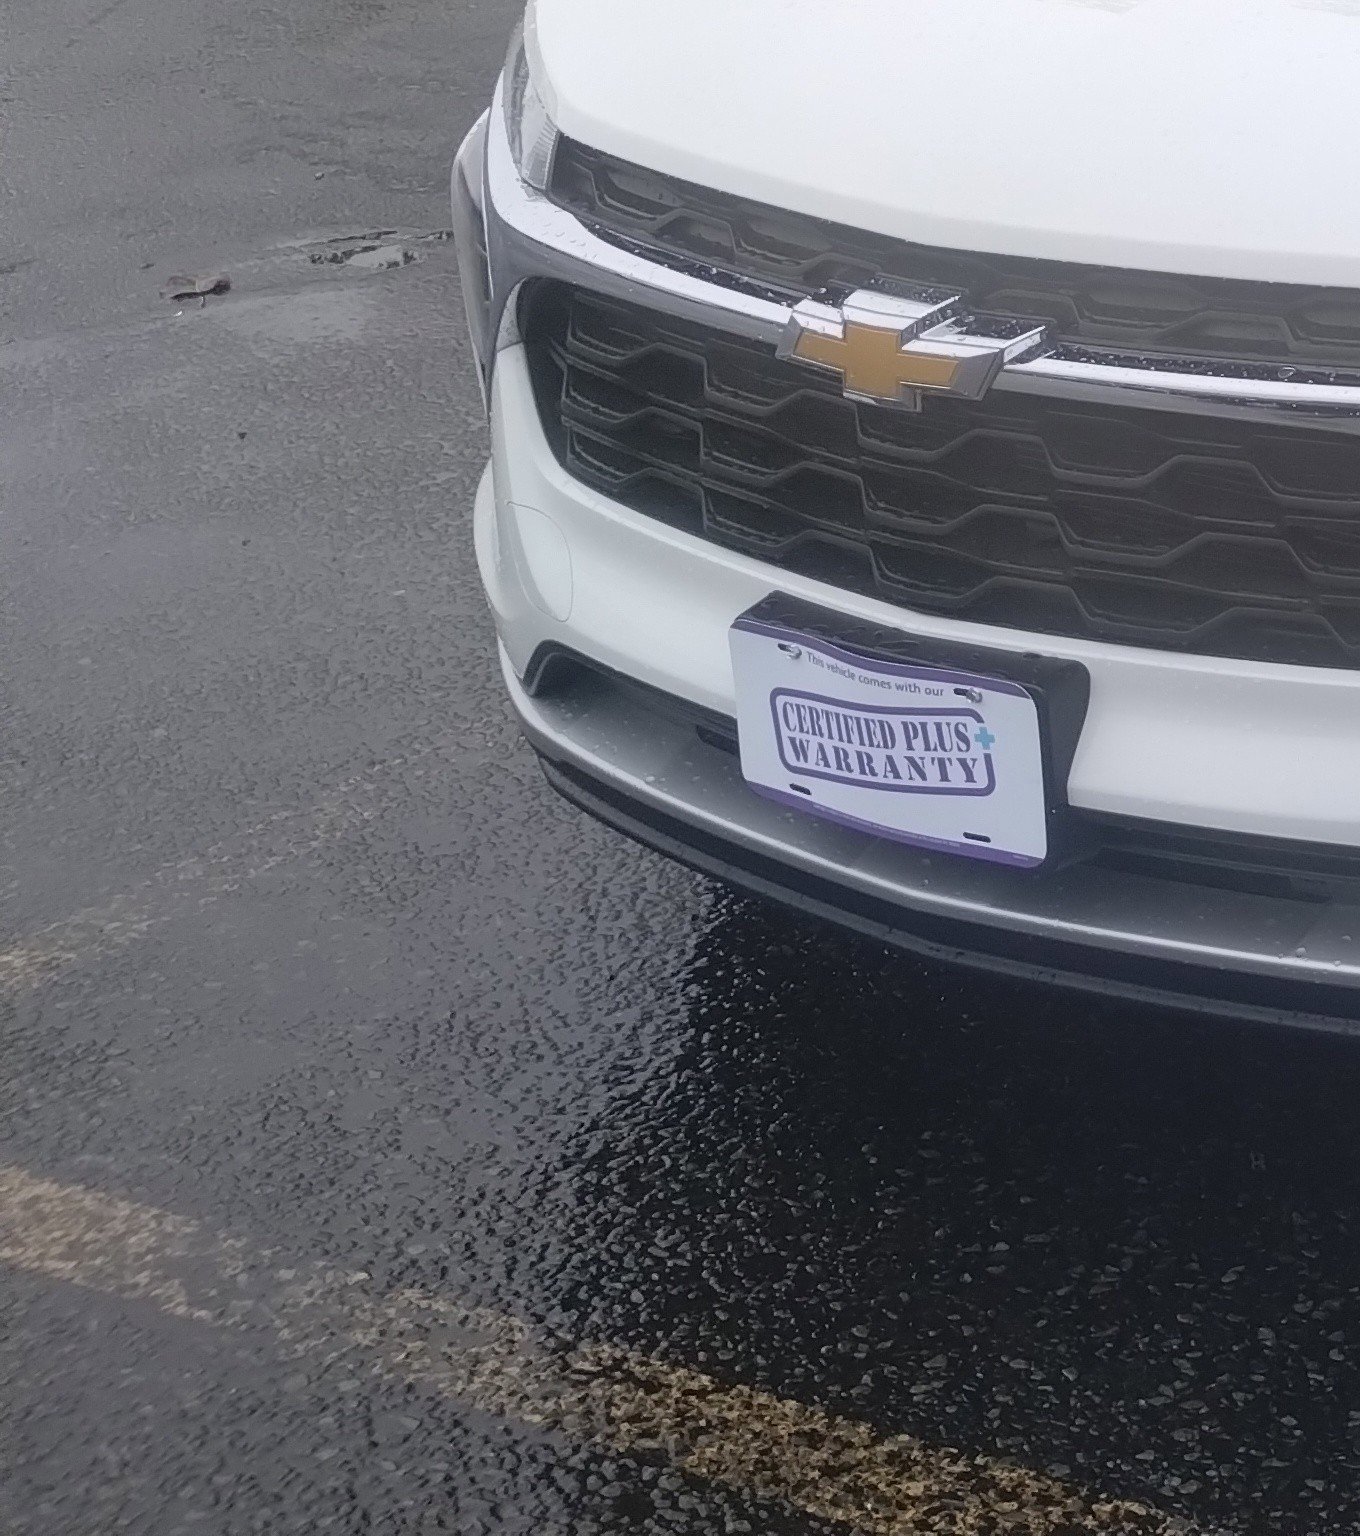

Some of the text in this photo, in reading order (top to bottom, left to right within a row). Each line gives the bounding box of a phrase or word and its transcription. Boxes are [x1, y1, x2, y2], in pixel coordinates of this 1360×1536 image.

[806, 651, 944, 697] This vehicle comes with our
[782, 701, 972, 753] CERTIFIED PLUS
[787, 736, 979, 784] WARRANTY
